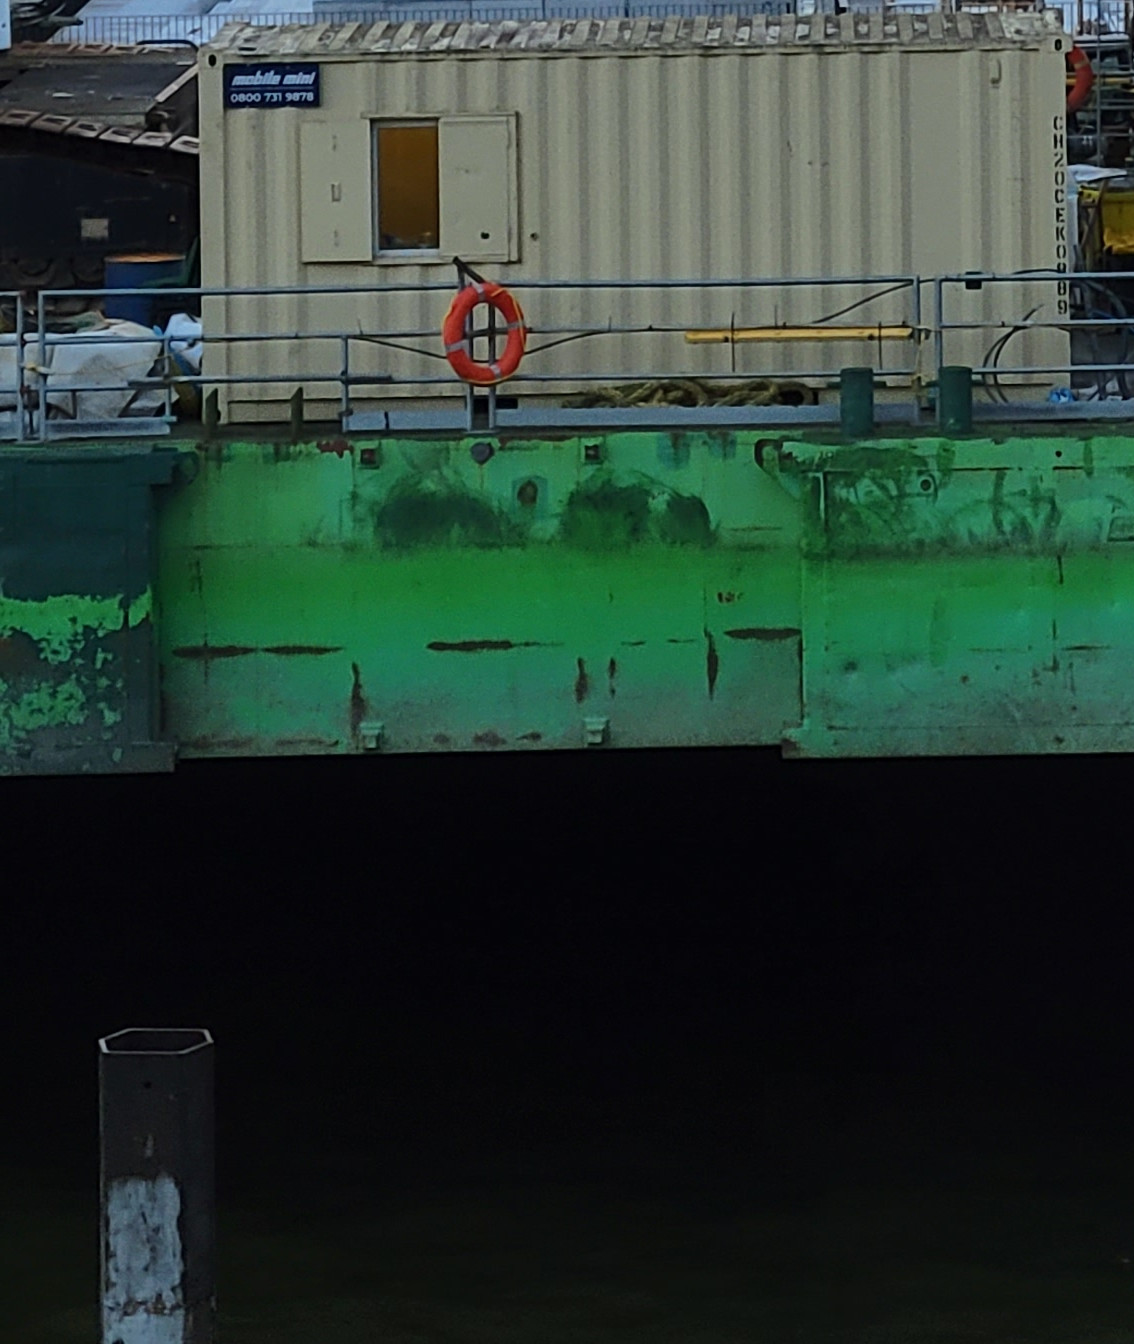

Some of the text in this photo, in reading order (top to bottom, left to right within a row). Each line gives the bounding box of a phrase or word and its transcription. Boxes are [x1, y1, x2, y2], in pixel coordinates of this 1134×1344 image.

[231, 70, 316, 86] mobile mini
[230, 92, 314, 102] 0800 731 9878
